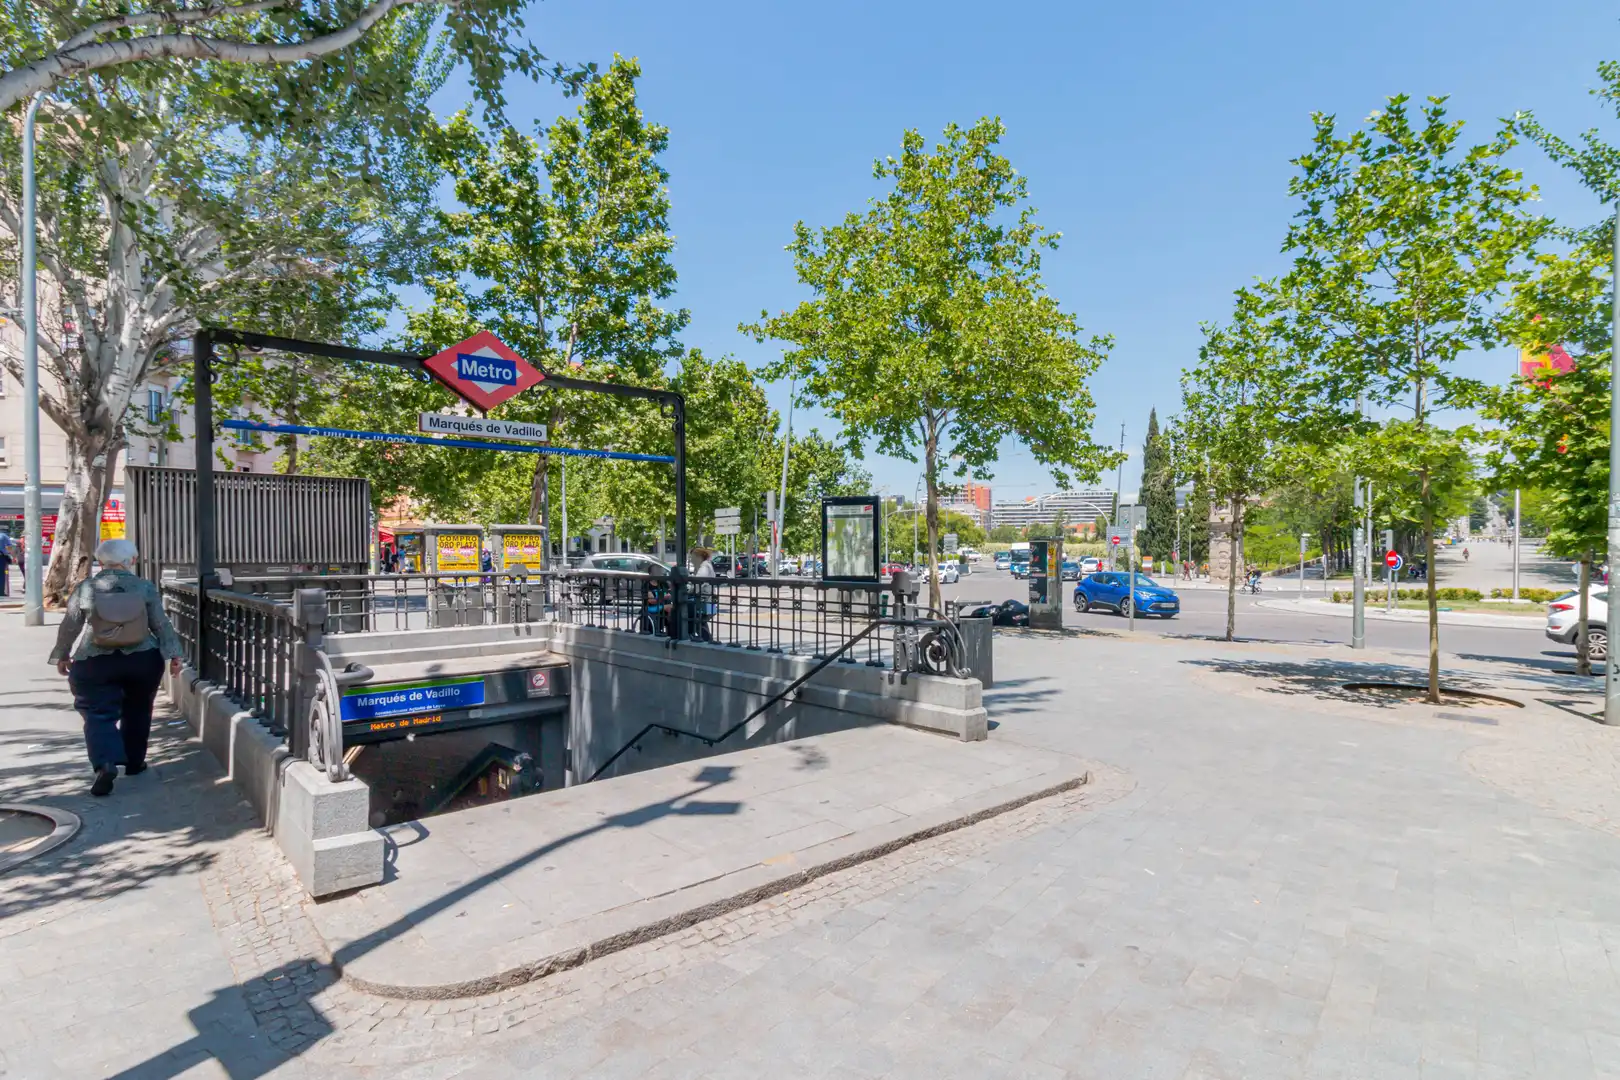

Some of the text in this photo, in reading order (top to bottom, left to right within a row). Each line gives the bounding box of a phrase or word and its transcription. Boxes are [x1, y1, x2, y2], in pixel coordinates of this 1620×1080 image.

[461, 358, 513, 381] Metro
[429, 417, 543, 438] Marqués de Vadillo
[357, 687, 461, 707] Marqués de Vadillo
[370, 722, 396, 730] Metro
[413, 716, 442, 725] Madrid
